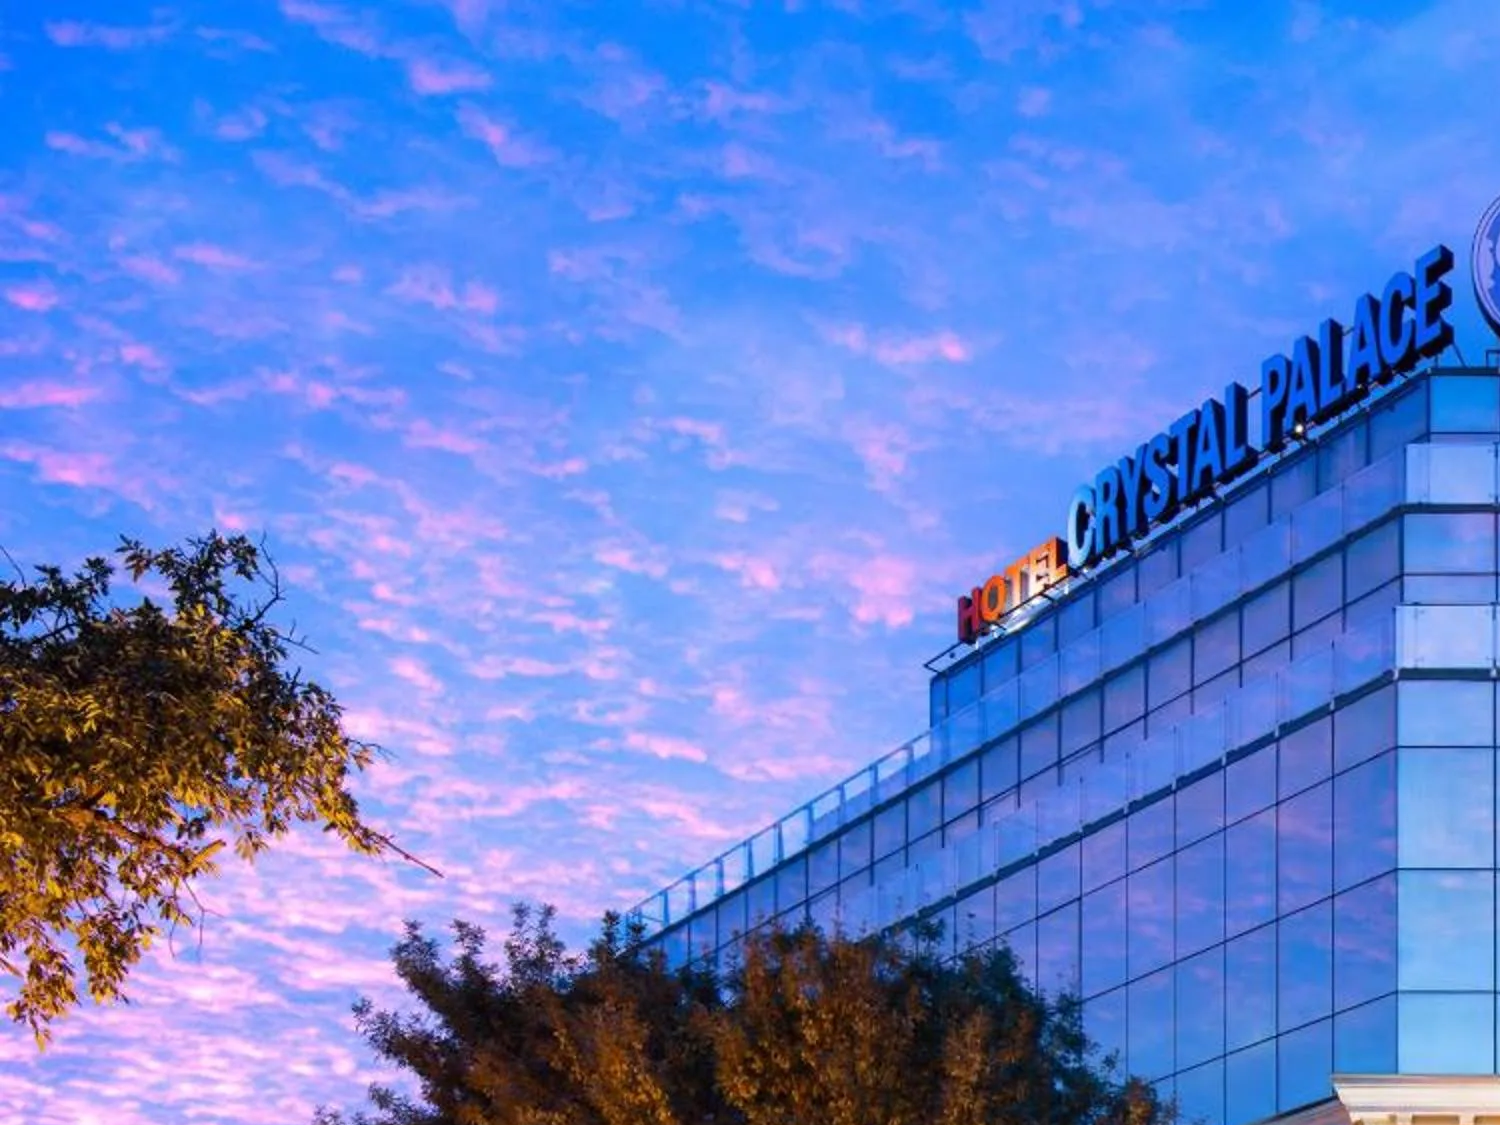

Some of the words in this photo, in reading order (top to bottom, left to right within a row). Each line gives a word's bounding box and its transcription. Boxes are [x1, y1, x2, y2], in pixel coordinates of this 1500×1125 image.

[957, 536, 1068, 643] HOTEL
[1067, 382, 1252, 568] CRYSTAL
[1262, 244, 1454, 453] PALACE
